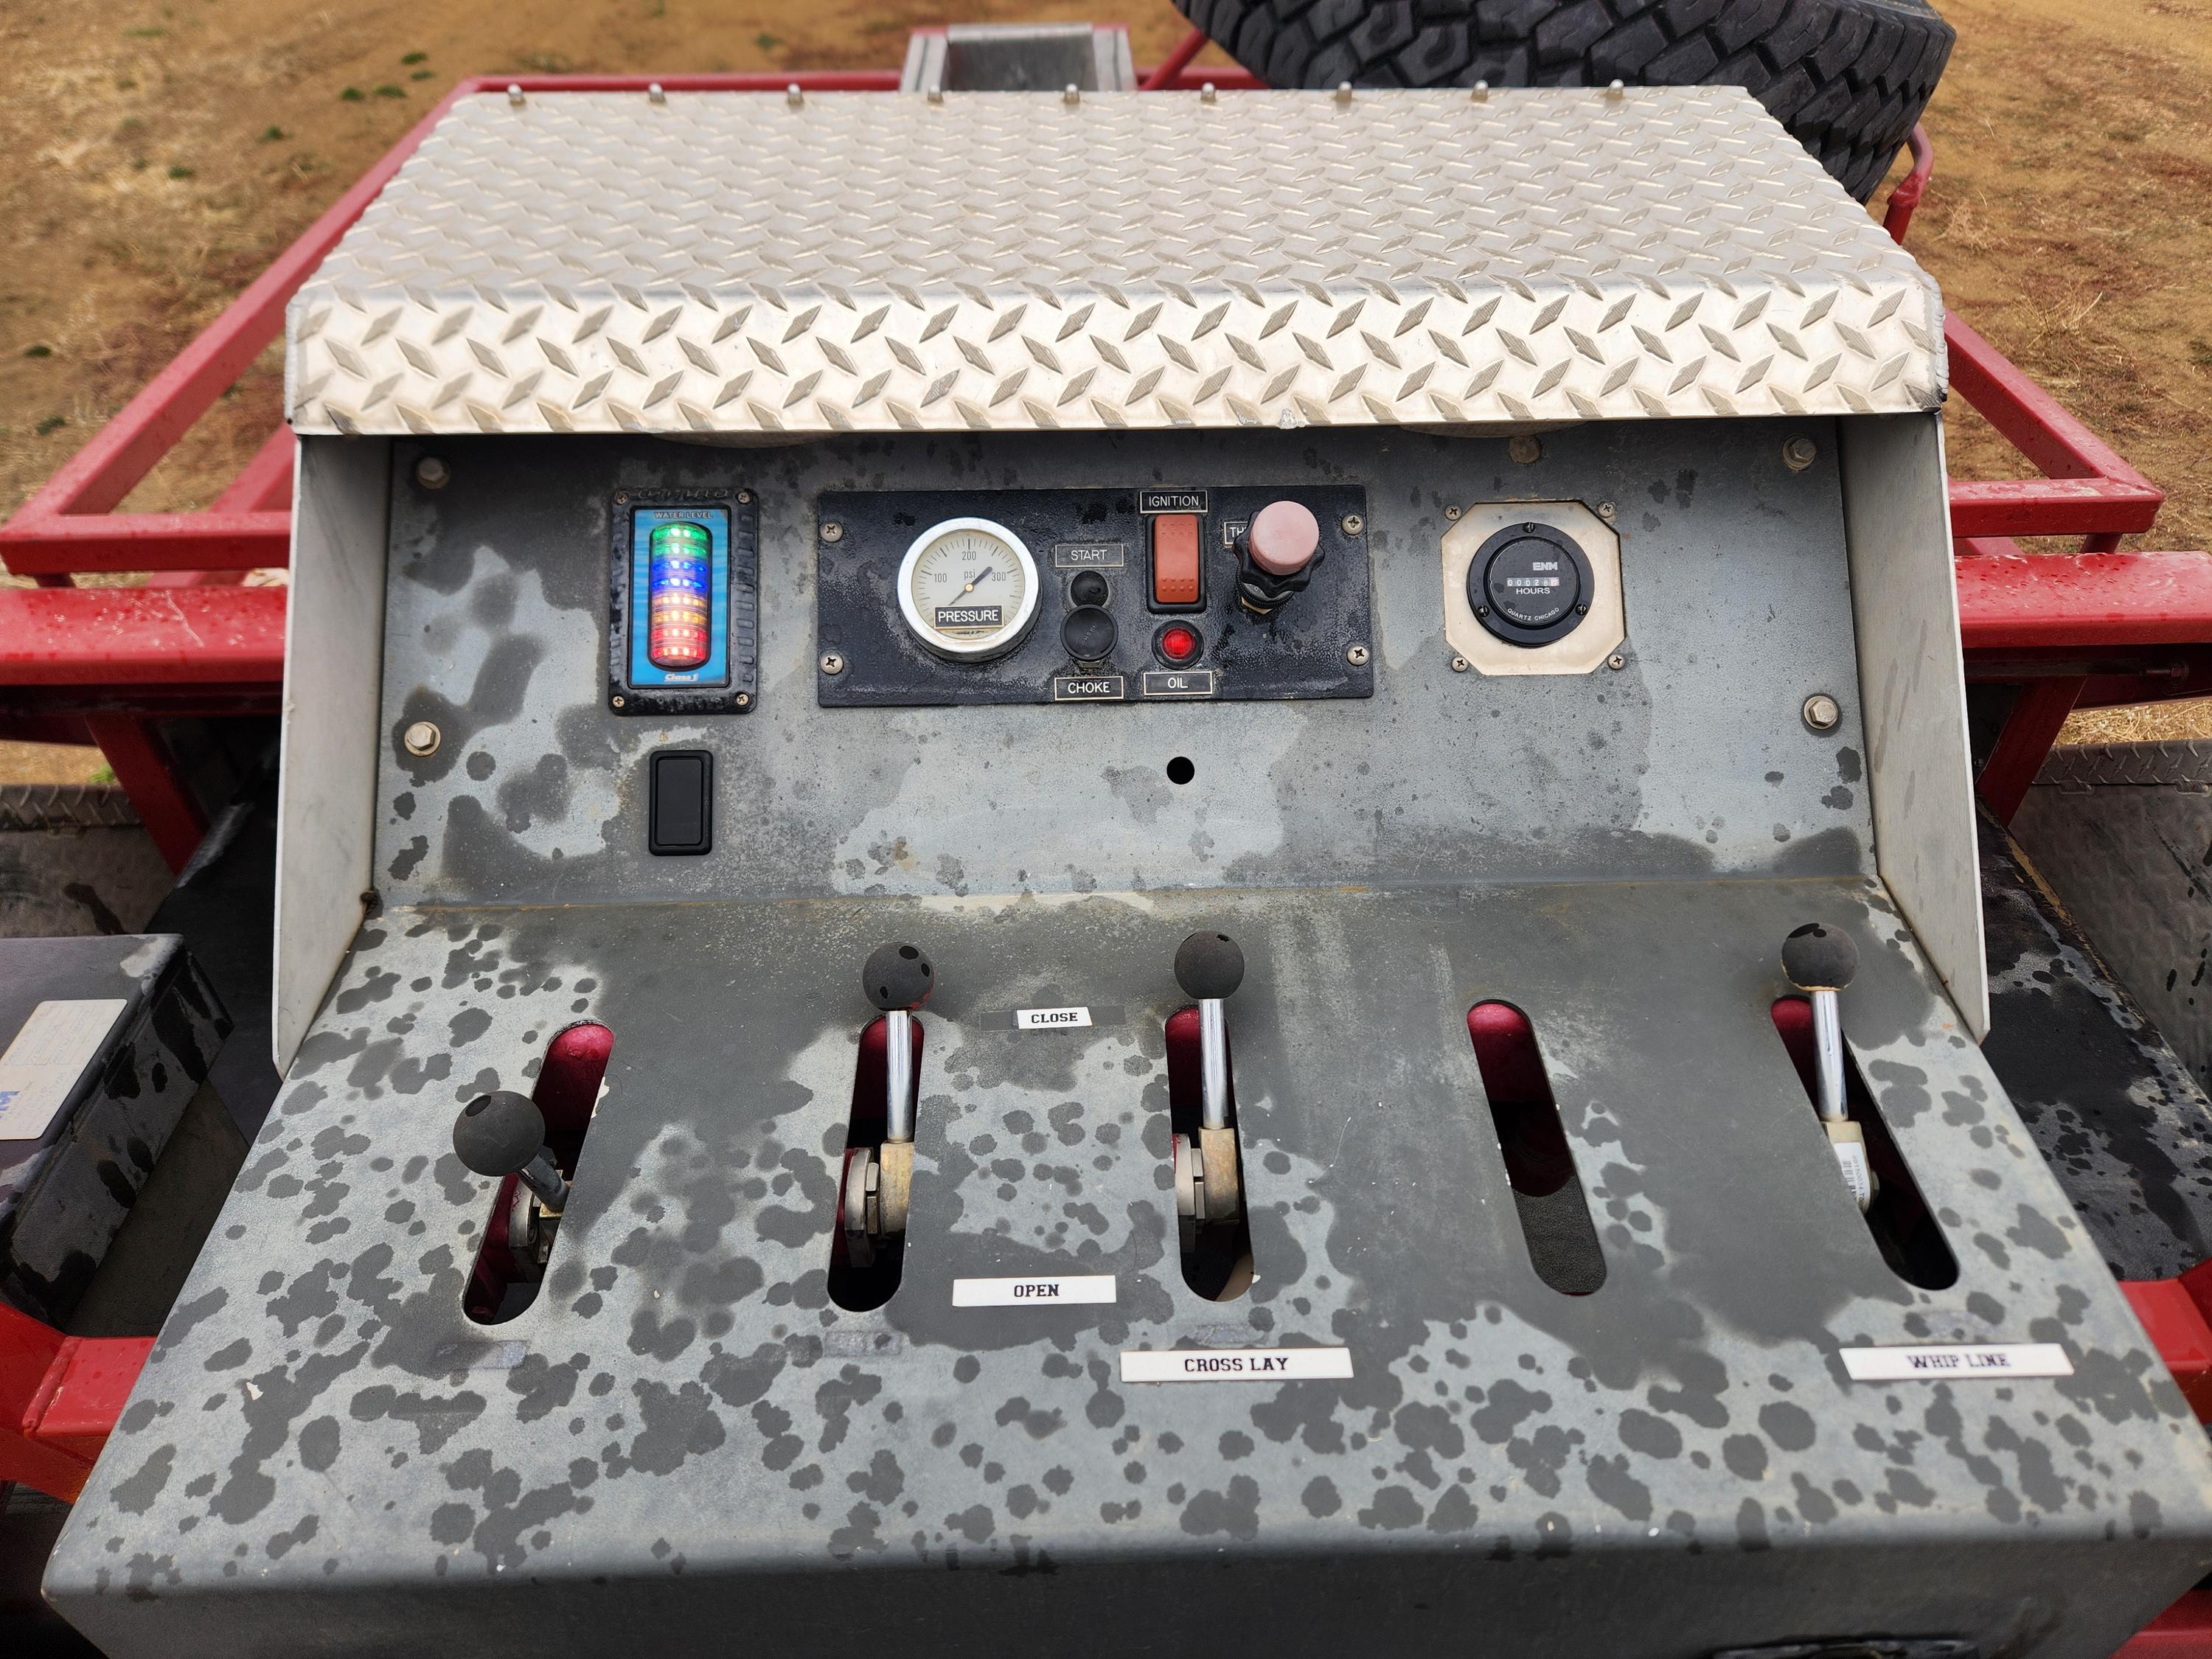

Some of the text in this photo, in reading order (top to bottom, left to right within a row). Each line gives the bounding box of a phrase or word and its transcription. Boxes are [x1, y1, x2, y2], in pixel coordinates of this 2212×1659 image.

[1149, 495, 1200, 507] IGNITION
[686, 511, 713, 519] LEVEL
[1229, 526, 1247, 538] TH
[962, 551, 977, 560] 200
[1071, 549, 1108, 561] START
[1533, 562, 1558, 571] ENM
[934, 574, 947, 582] 100
[964, 569, 975, 580] psi
[992, 572, 1006, 582] 300
[1516, 587, 1551, 595] HOURS
[938, 610, 999, 622] PRESSURE
[1506, 607, 1560, 621] QUARTZ CHICAGO
[1068, 682, 1110, 694] CHOKE
[1167, 678, 1189, 689] OIL
[1031, 1012, 1079, 1023] CLOSE
[1014, 1284, 1060, 1298] OPEN
[1184, 1357, 1289, 1372] CROSS LAY
[1907, 1354, 2011, 1368] WHIP LINE
